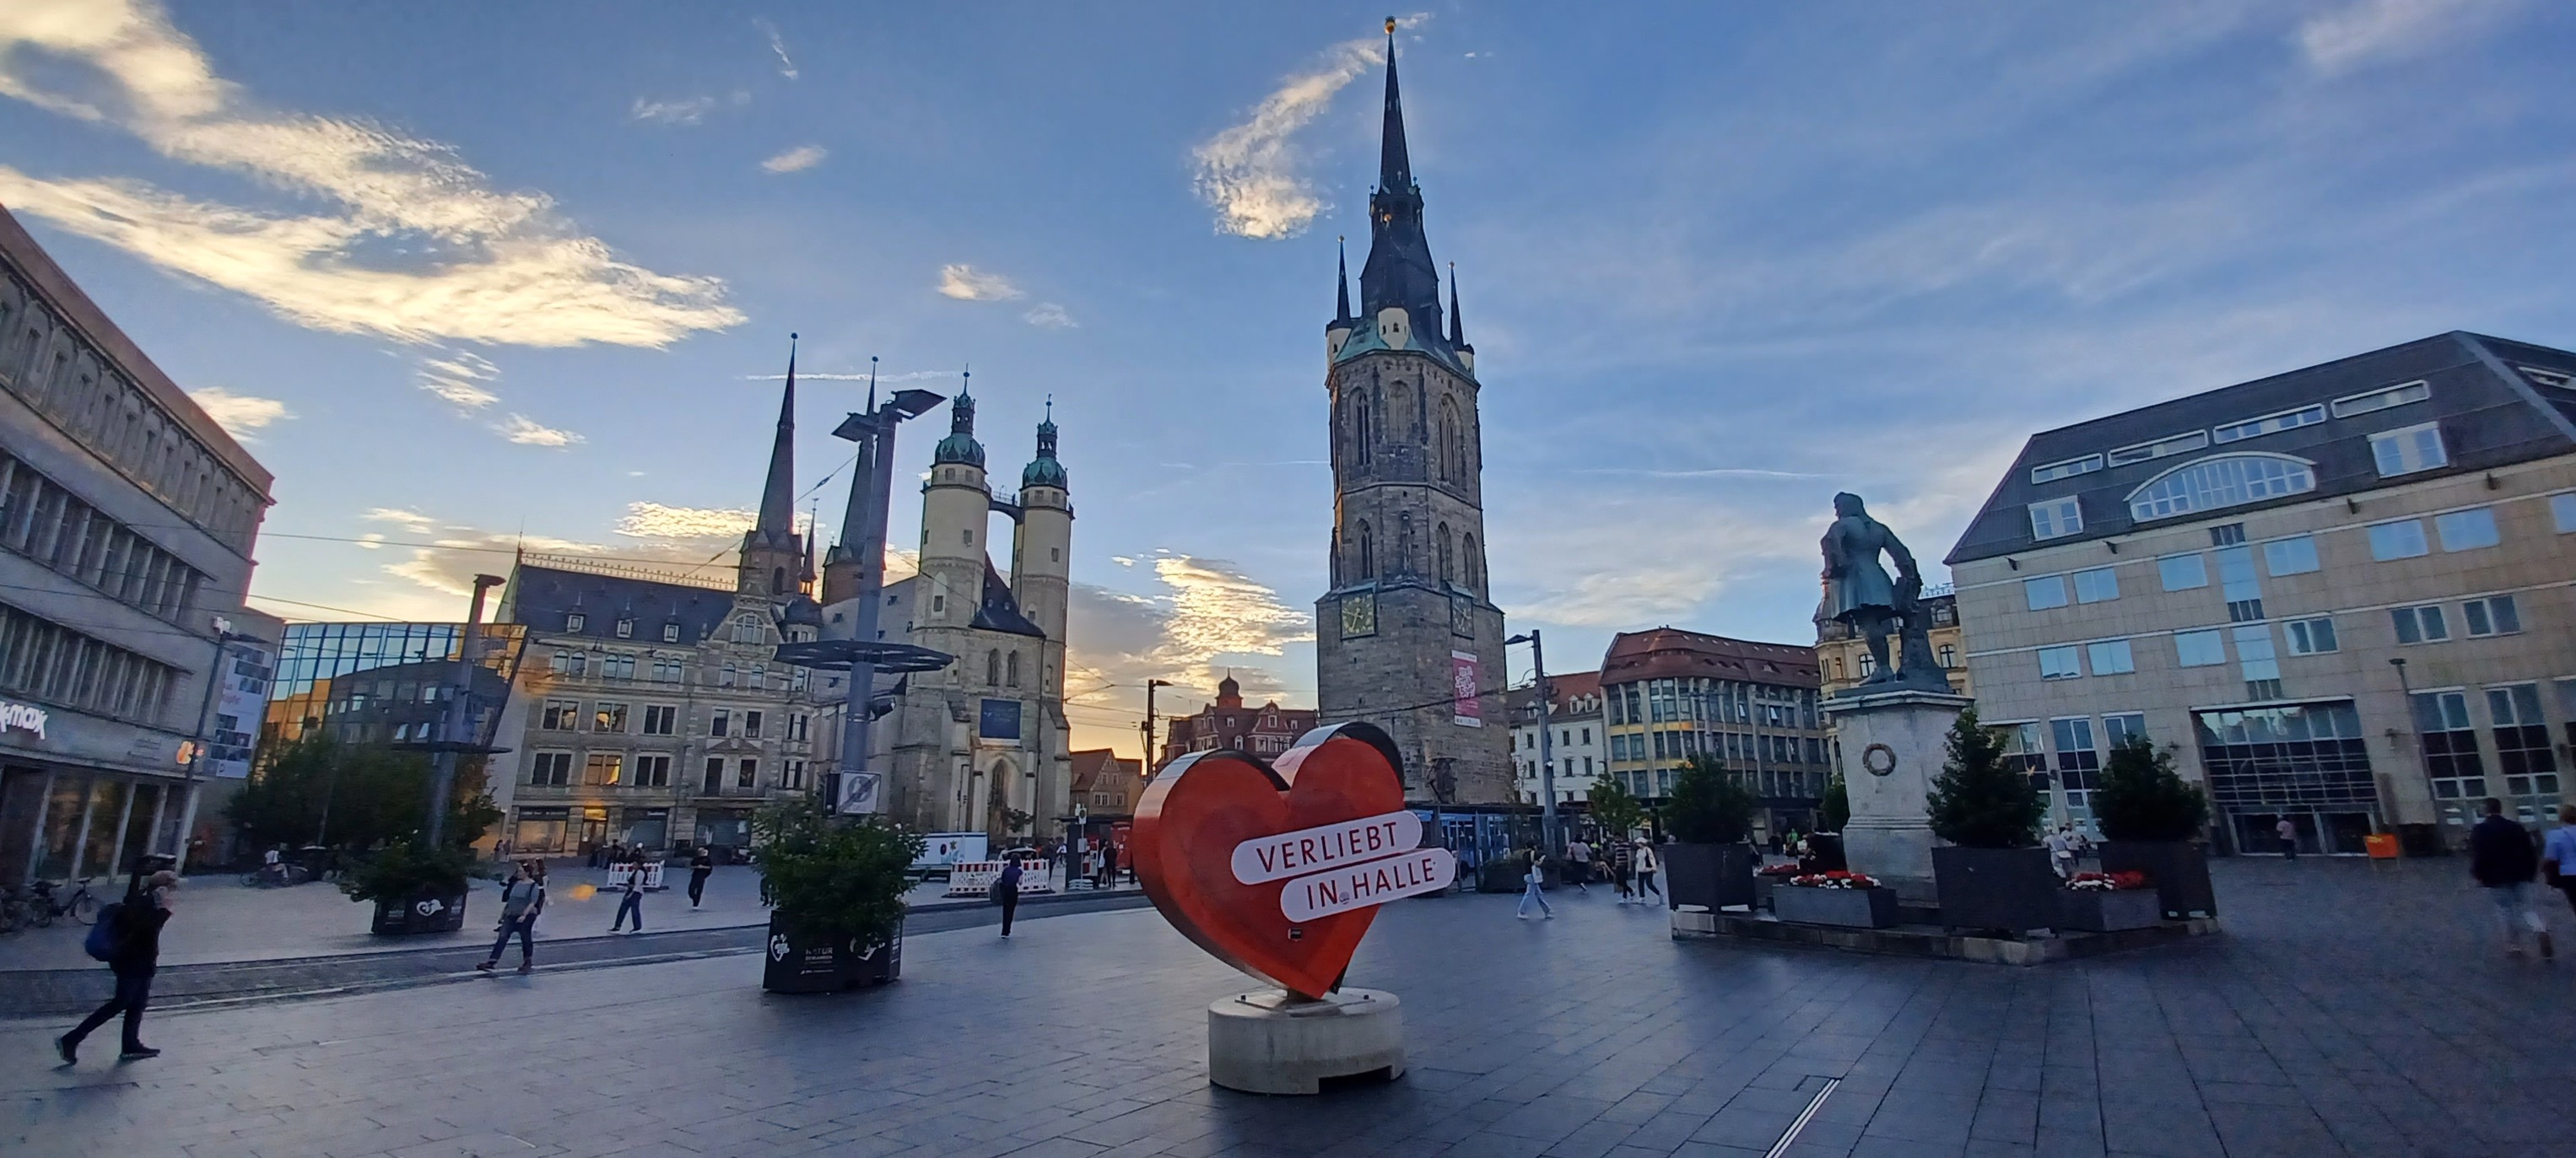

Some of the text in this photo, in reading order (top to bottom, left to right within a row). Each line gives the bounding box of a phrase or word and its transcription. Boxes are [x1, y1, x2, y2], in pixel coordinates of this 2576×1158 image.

[1256, 821, 1397, 873] VERLIEBT
[1307, 858, 1435, 910] IN HALLE
